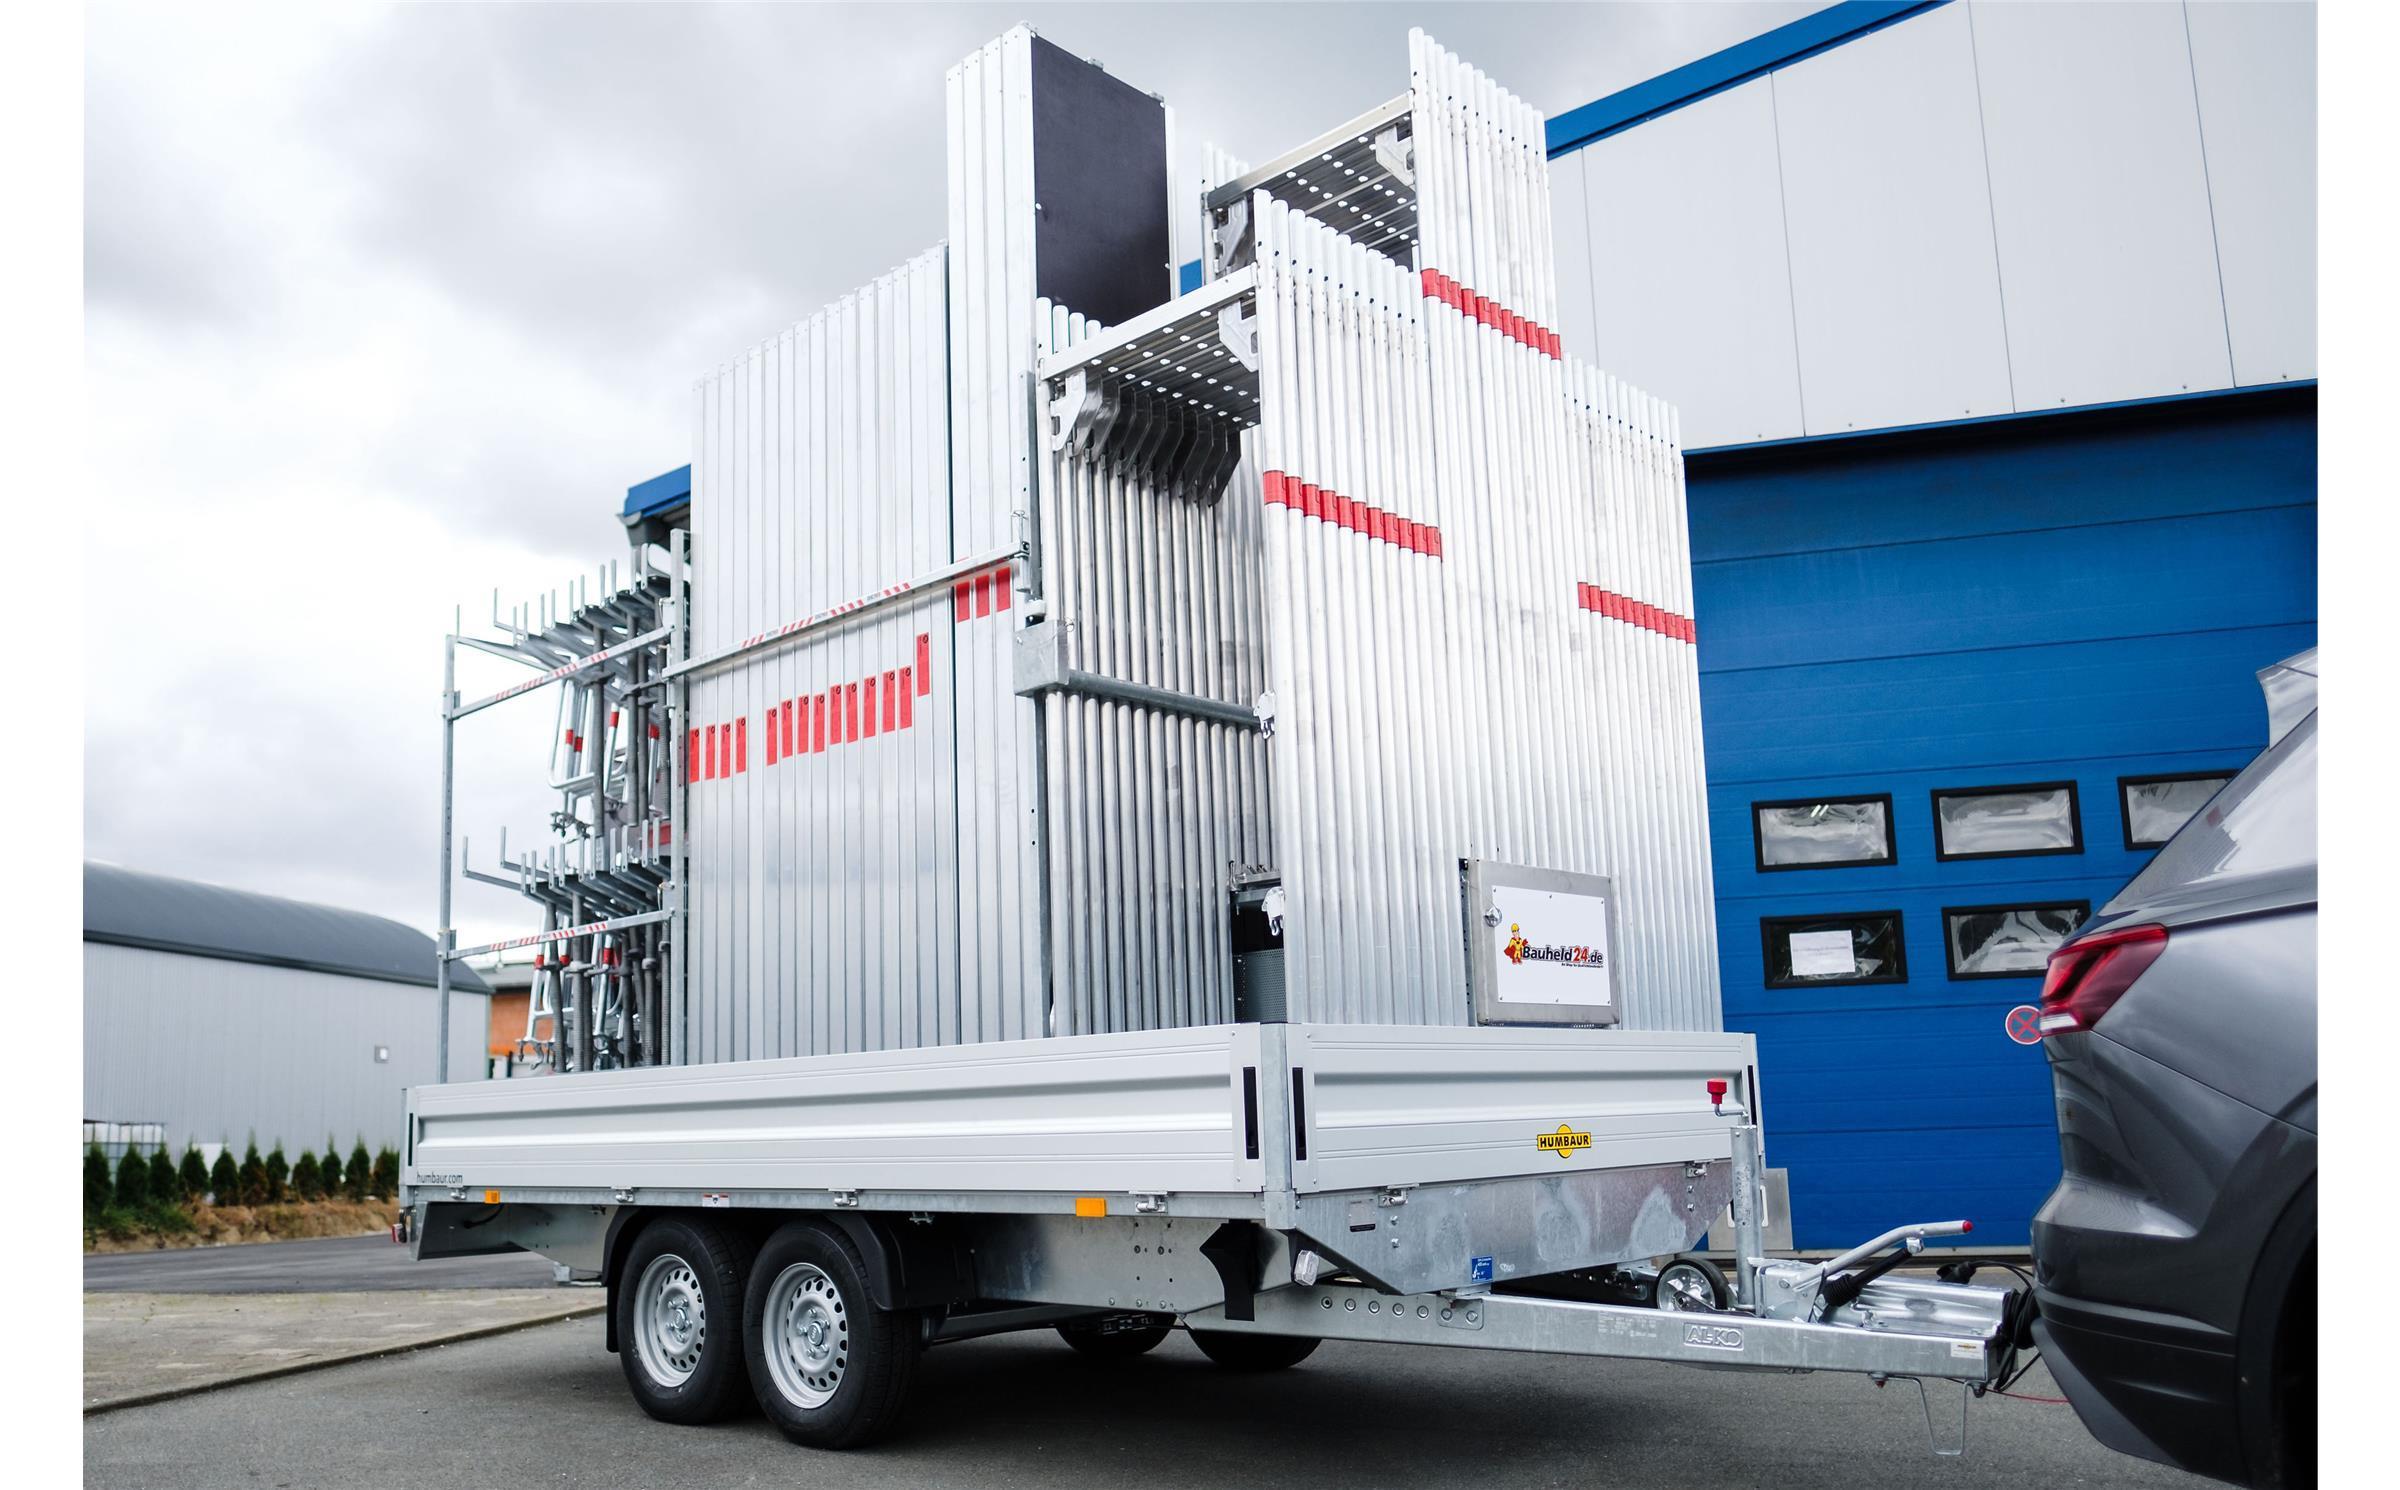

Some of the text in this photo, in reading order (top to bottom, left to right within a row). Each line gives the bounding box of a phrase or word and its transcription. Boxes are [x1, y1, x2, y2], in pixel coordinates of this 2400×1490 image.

[1522, 945, 1603, 963] Bauheld24.de
[1539, 1135, 1589, 1148] HUMBAUR
[416, 1171, 463, 1184] humbaur.com
